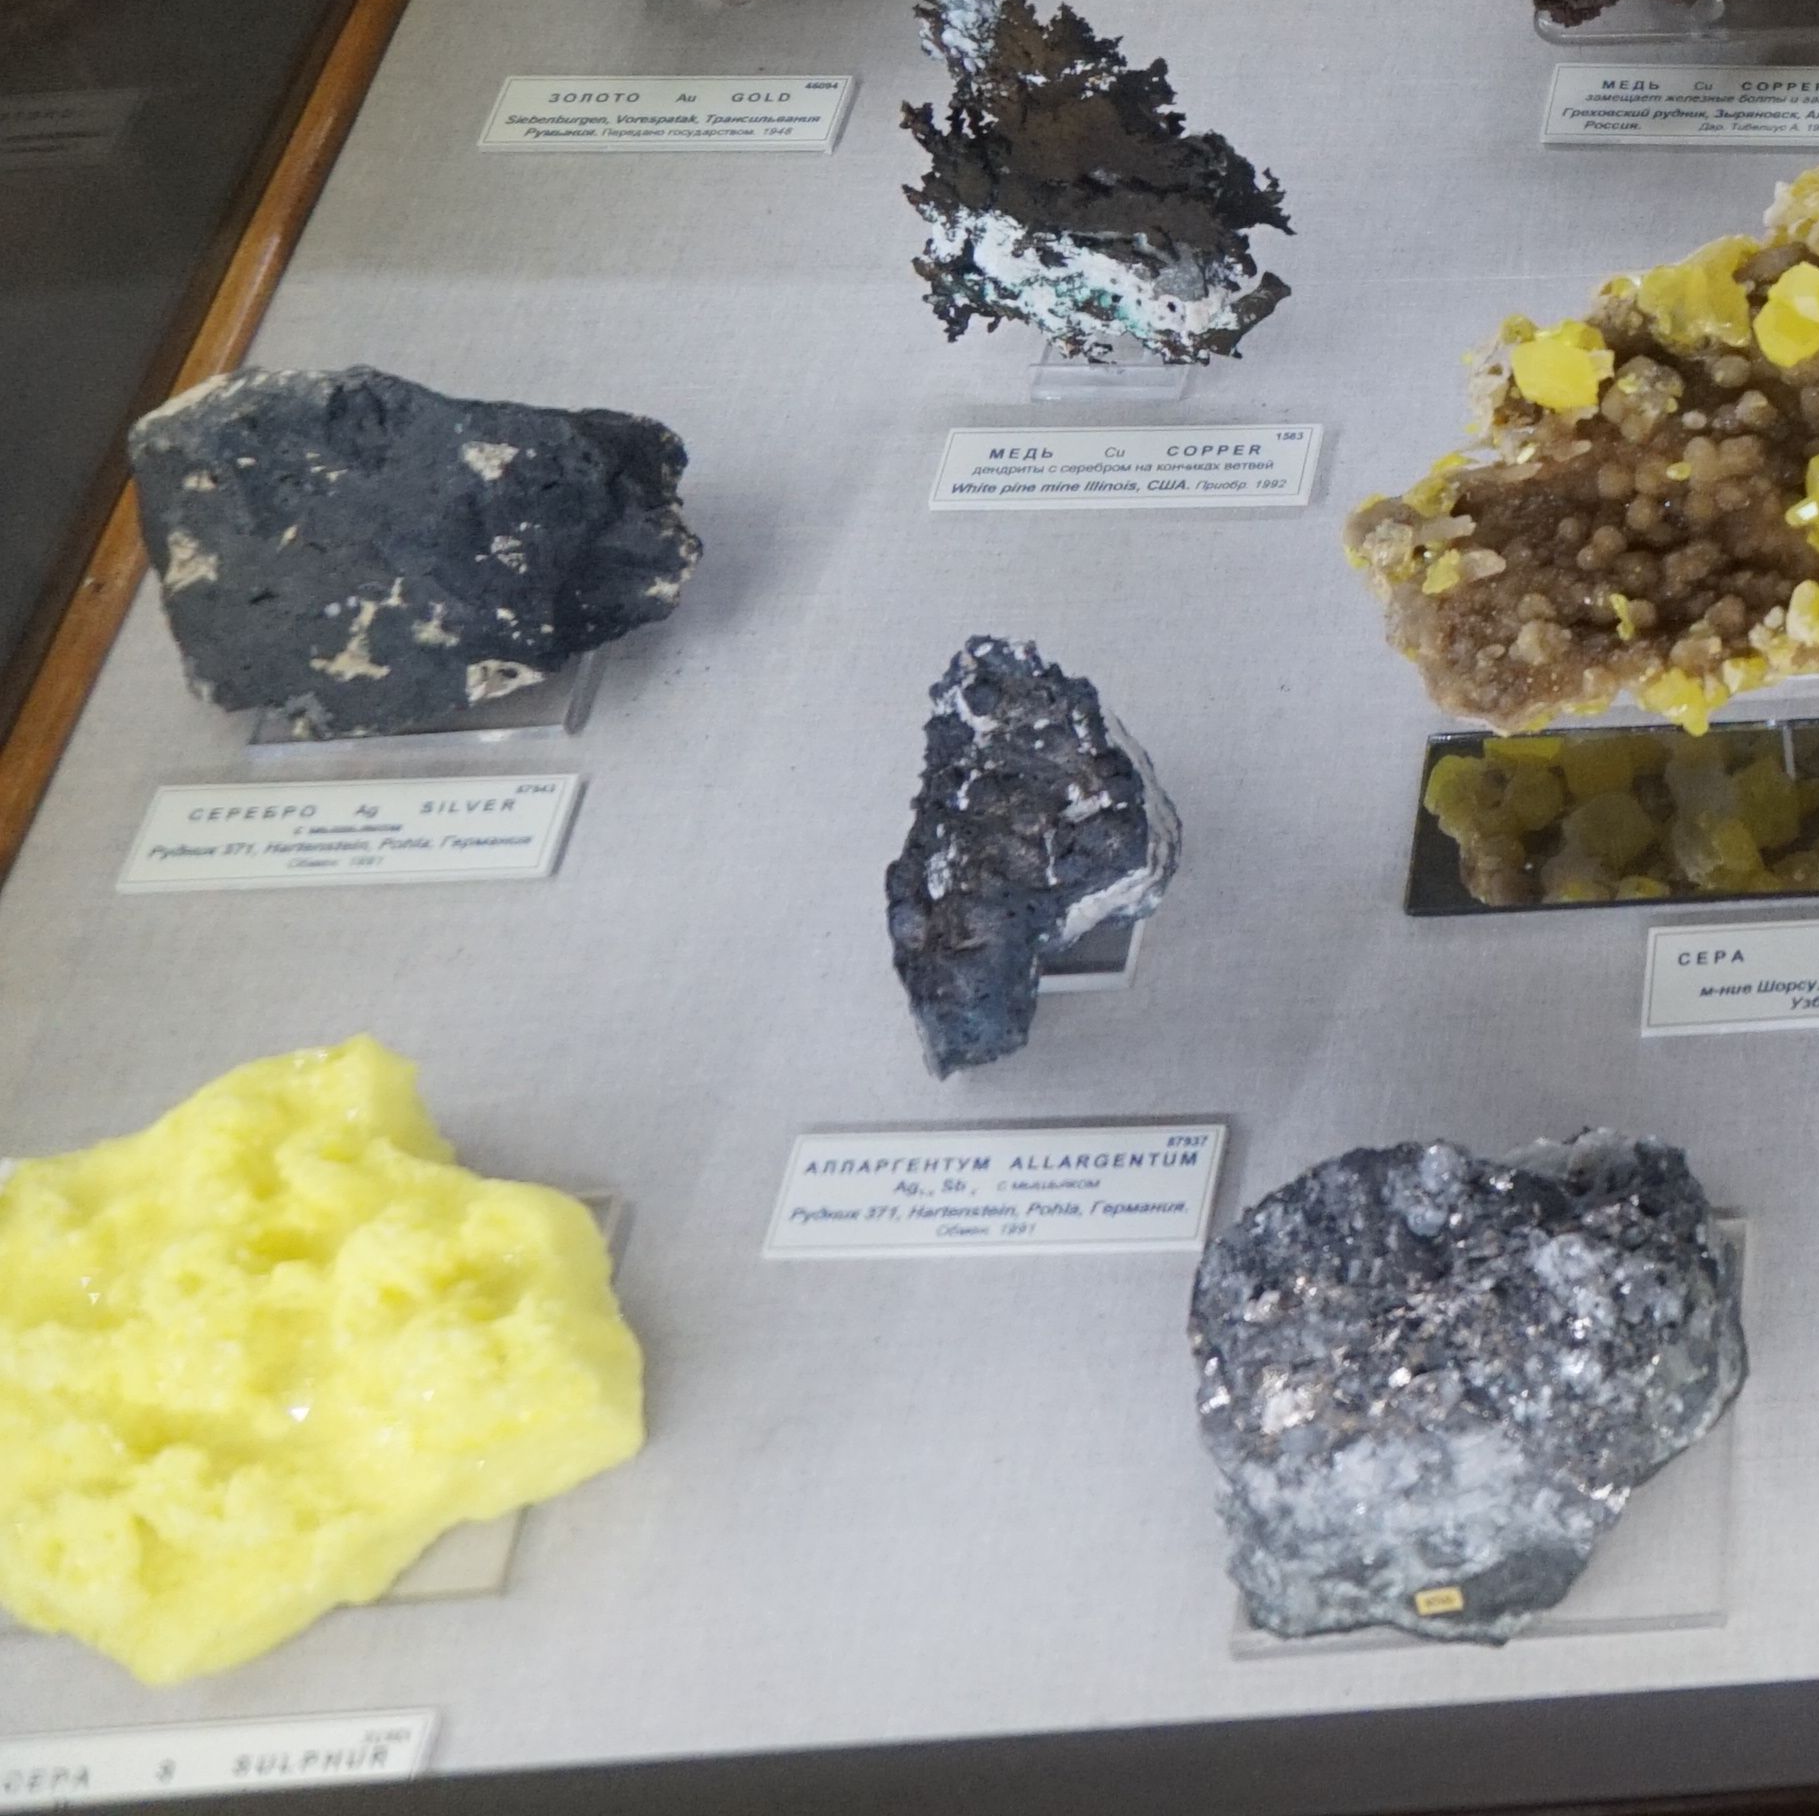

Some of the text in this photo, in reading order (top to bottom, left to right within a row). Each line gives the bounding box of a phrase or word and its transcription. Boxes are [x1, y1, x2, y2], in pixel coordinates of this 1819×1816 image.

[1601, 79, 1660, 91] МЕДЬ
[1693, 81, 1714, 91] Cu
[548, 92, 791, 103] ЗОЛОТО Au GOLD
[1584, 93, 1663, 103] замещает
[1665, 93, 1735, 103] железные
[1738, 94, 1787, 104] болты
[989, 444, 1262, 460] МЕДЬ Cu COPPER
[971, 465, 1045, 476] дендриты
[1048, 465, 1057, 474] с
[1060, 462, 1132, 474] серебром
[1135, 463, 1153, 472] на
[1224, 460, 1275, 471] ветвей
[951, 482, 997, 494] White
[999, 483, 1036, 496] pine
[1040, 482, 1080, 493] mine
[1083, 480, 1141, 493] Illinois,
[1146, 479, 1190, 491] США.
[187, 798, 517, 822] СЕРЕБРО Ag SILVER
[1678, 948, 1746, 967] СЕРА
[1699, 984, 1753, 998] м-ние
[804, 1151, 1199, 1175] АЛЛАРГЕНТУМ ALLARGENTUM
[231, 1744, 390, 1778] SULPHUR
